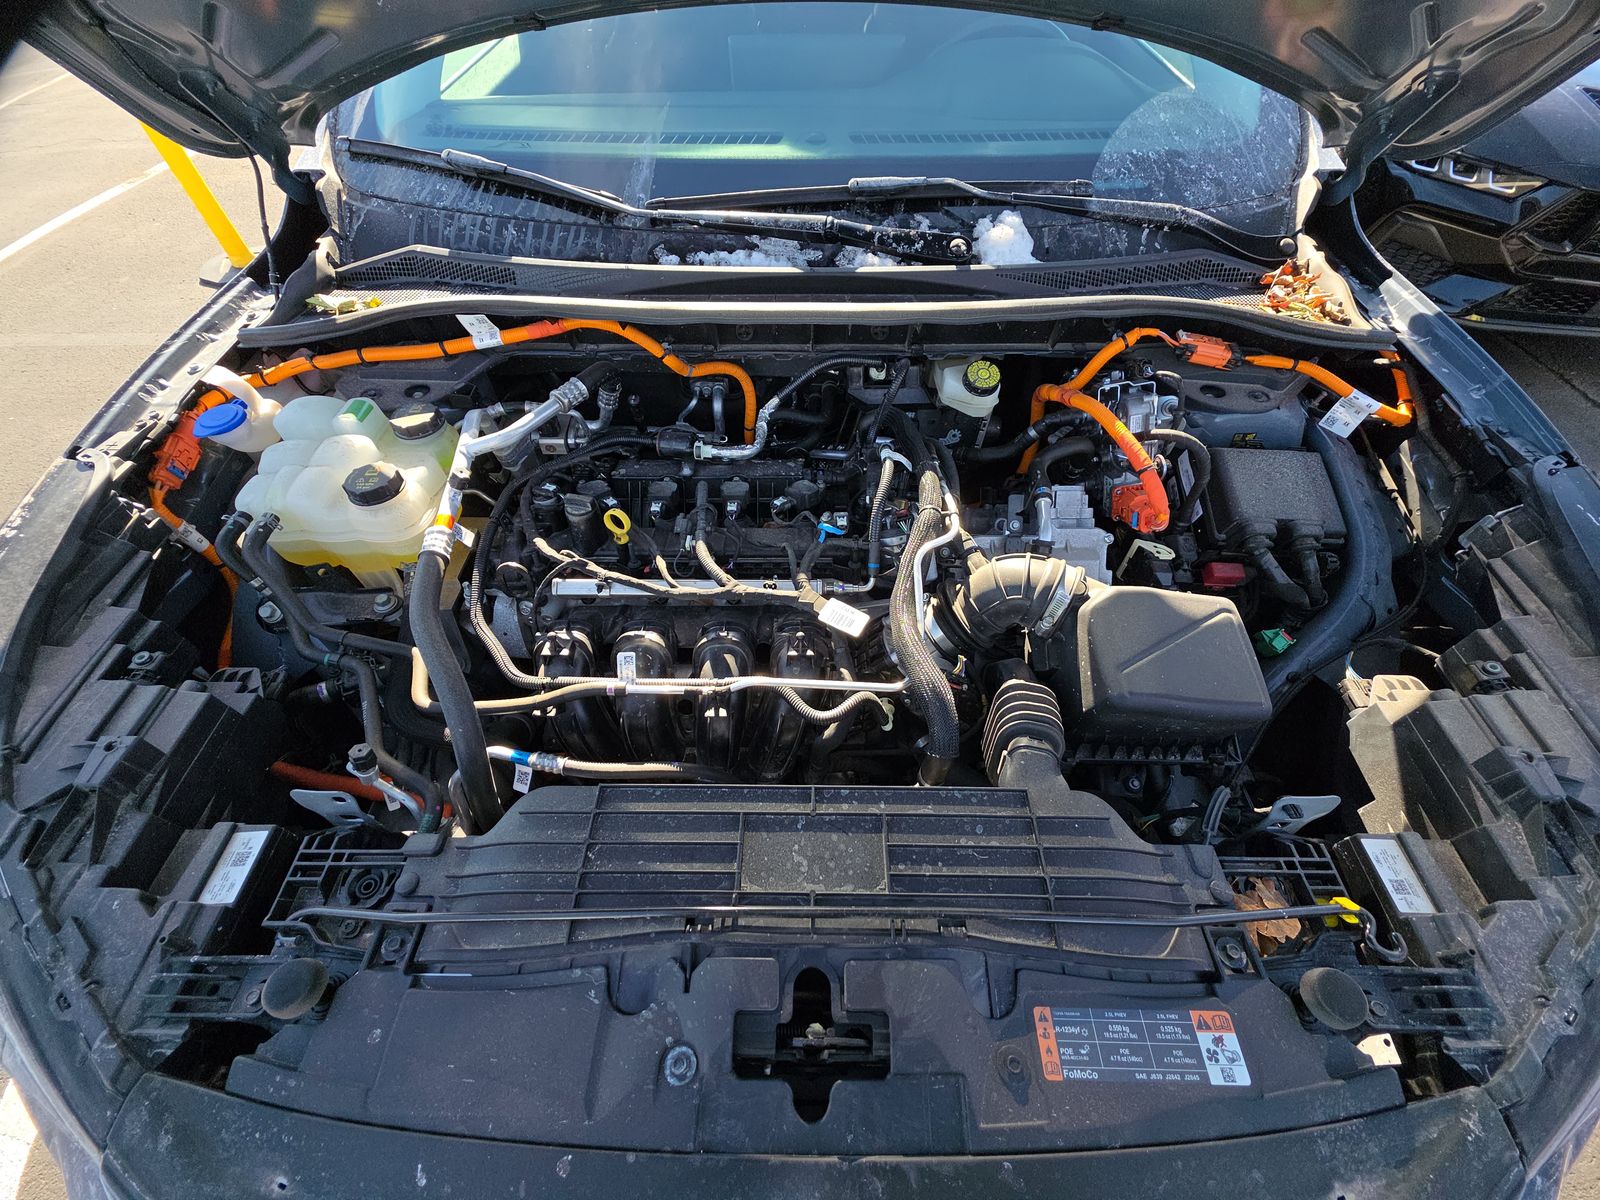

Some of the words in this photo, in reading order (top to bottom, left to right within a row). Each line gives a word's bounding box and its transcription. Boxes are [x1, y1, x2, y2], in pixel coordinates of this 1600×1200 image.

[1056, 1026, 1080, 1034] R-1234yf
[1122, 1024, 1130, 1033] kg
[1174, 1026, 1182, 1034] kg
[1060, 1047, 1074, 1055] POE
[1063, 1069, 1098, 1079] FoMoCo
